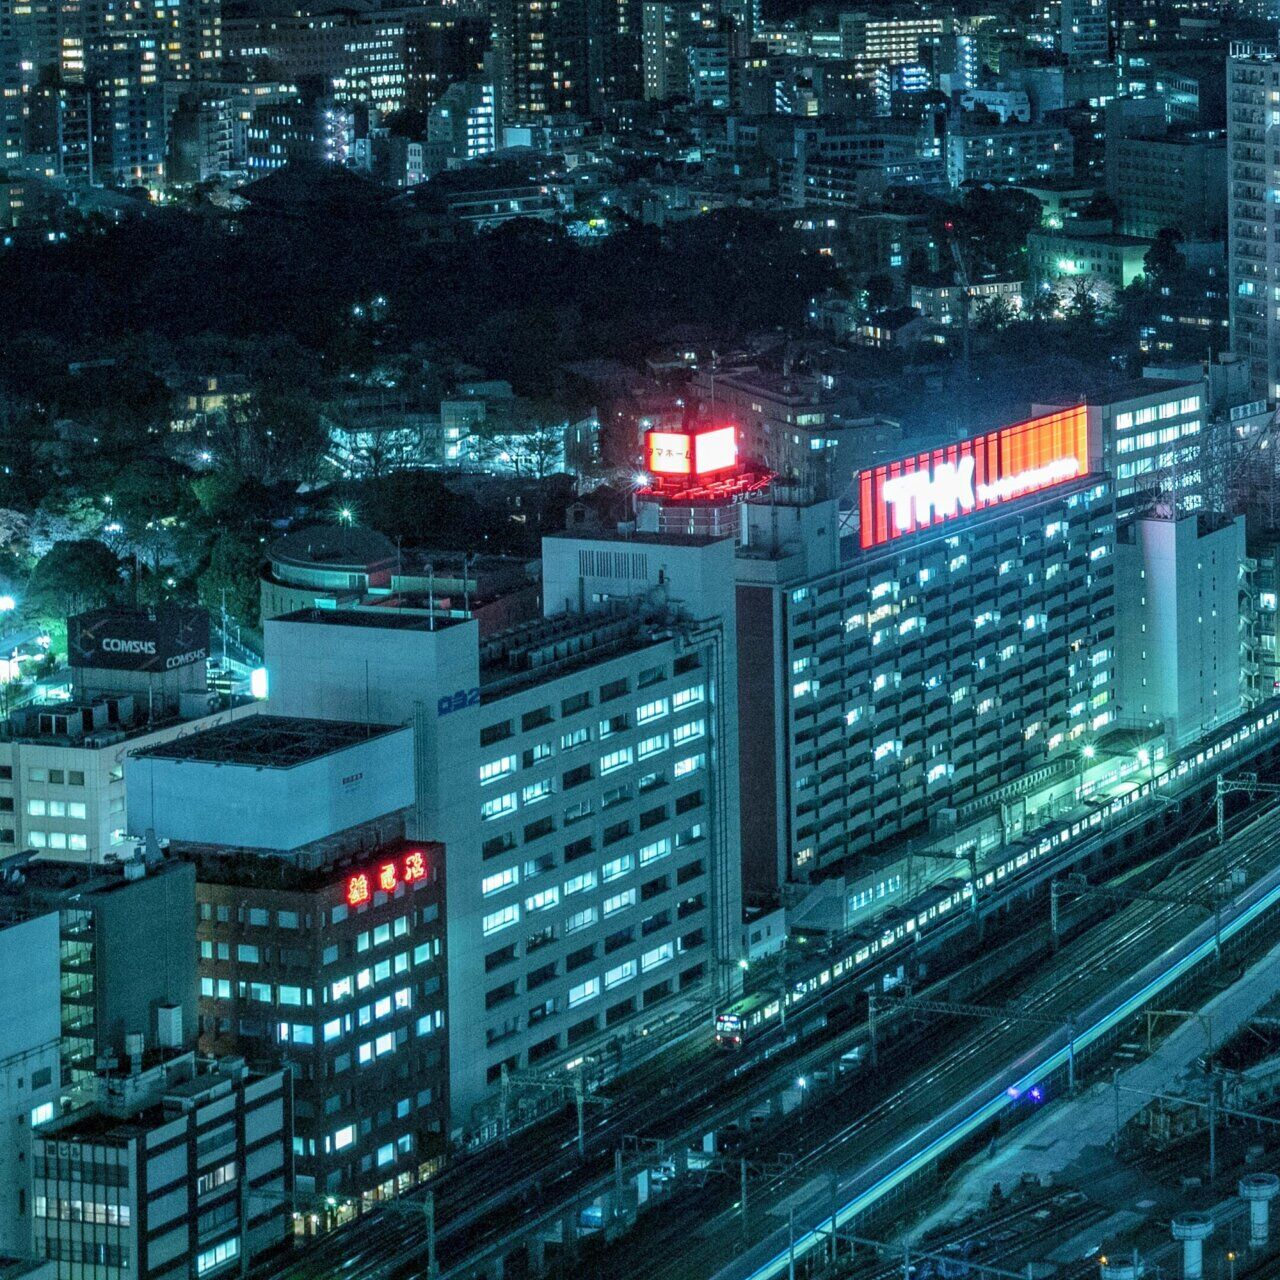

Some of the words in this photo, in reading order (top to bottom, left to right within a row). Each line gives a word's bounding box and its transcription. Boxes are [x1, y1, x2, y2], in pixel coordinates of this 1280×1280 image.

[647, 448, 691, 459] タマホーム
[883, 456, 974, 529] THK
[102, 638, 156, 655] COMSYS
[165, 647, 206, 669] COMSYS
